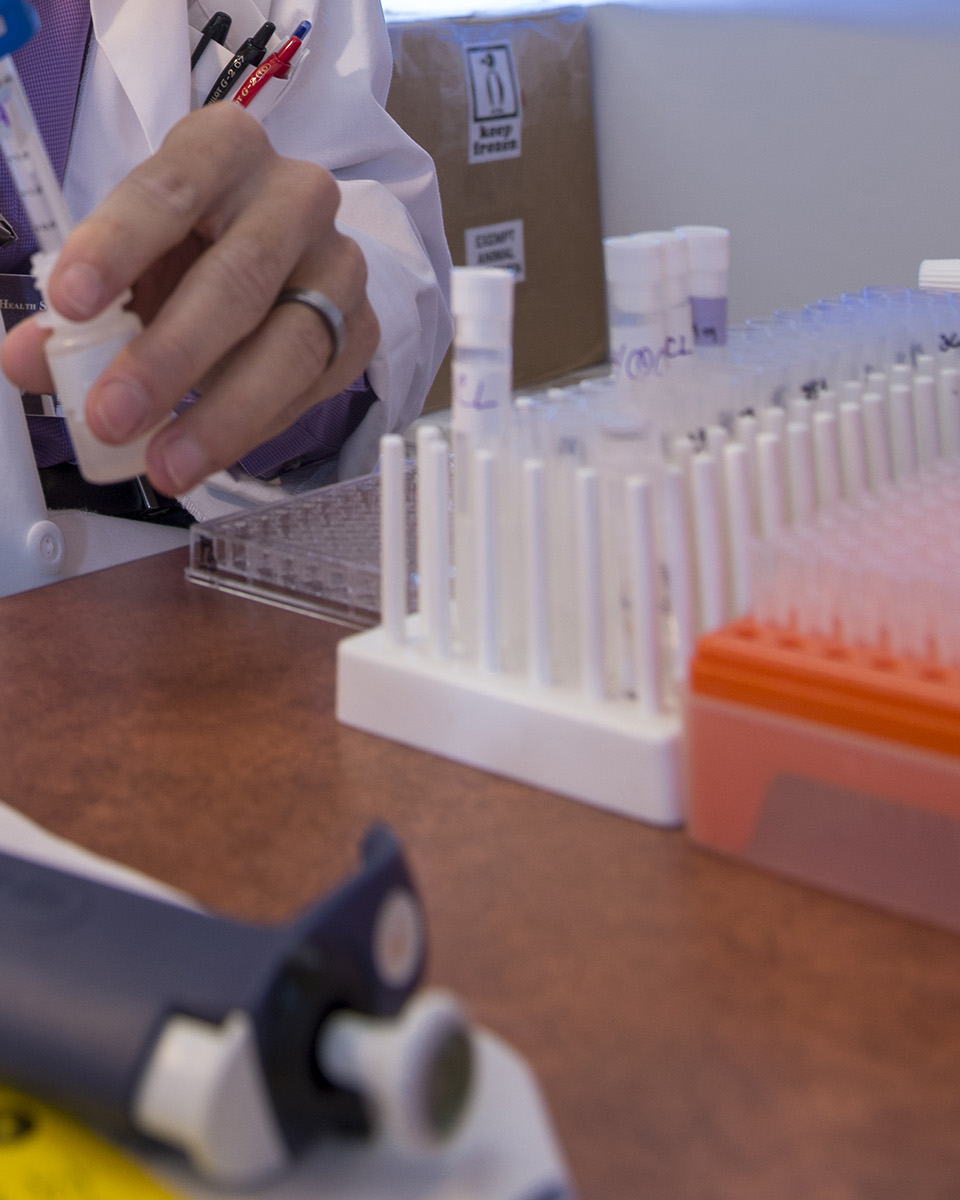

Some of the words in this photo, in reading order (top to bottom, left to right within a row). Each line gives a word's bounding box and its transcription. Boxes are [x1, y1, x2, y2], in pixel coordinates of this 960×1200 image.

[479, 123, 513, 141] keep
[473, 138, 518, 158] frozen
[0, 298, 37, 311] HEALTH
